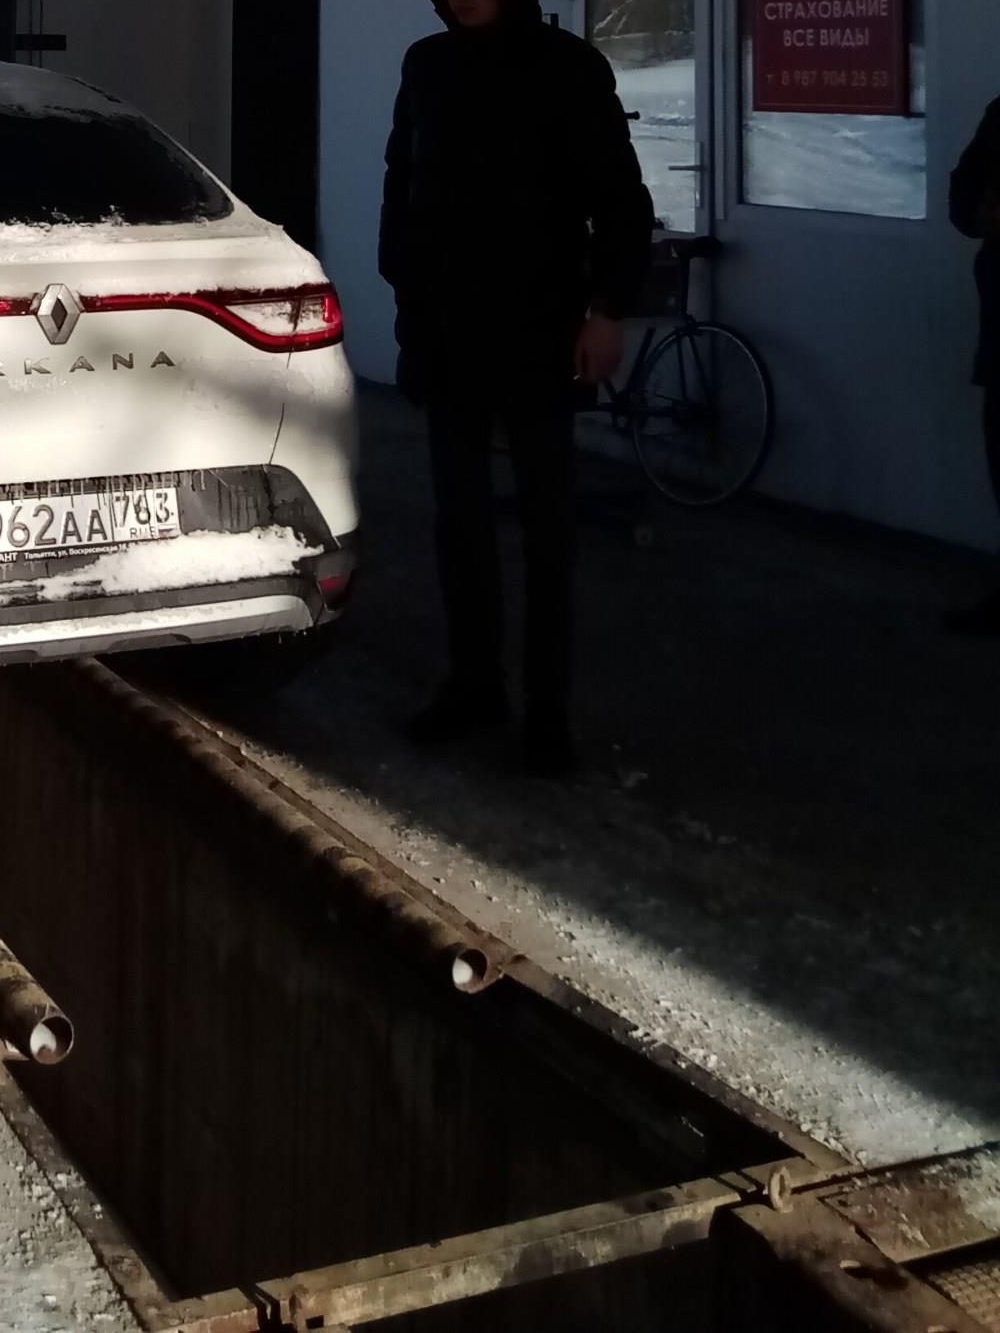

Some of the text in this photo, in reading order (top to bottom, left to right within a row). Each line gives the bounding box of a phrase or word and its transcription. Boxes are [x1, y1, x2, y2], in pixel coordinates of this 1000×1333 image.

[783, 27, 869, 47] ВСЕ ВИДЫ
[115, 493, 170, 527] 763
